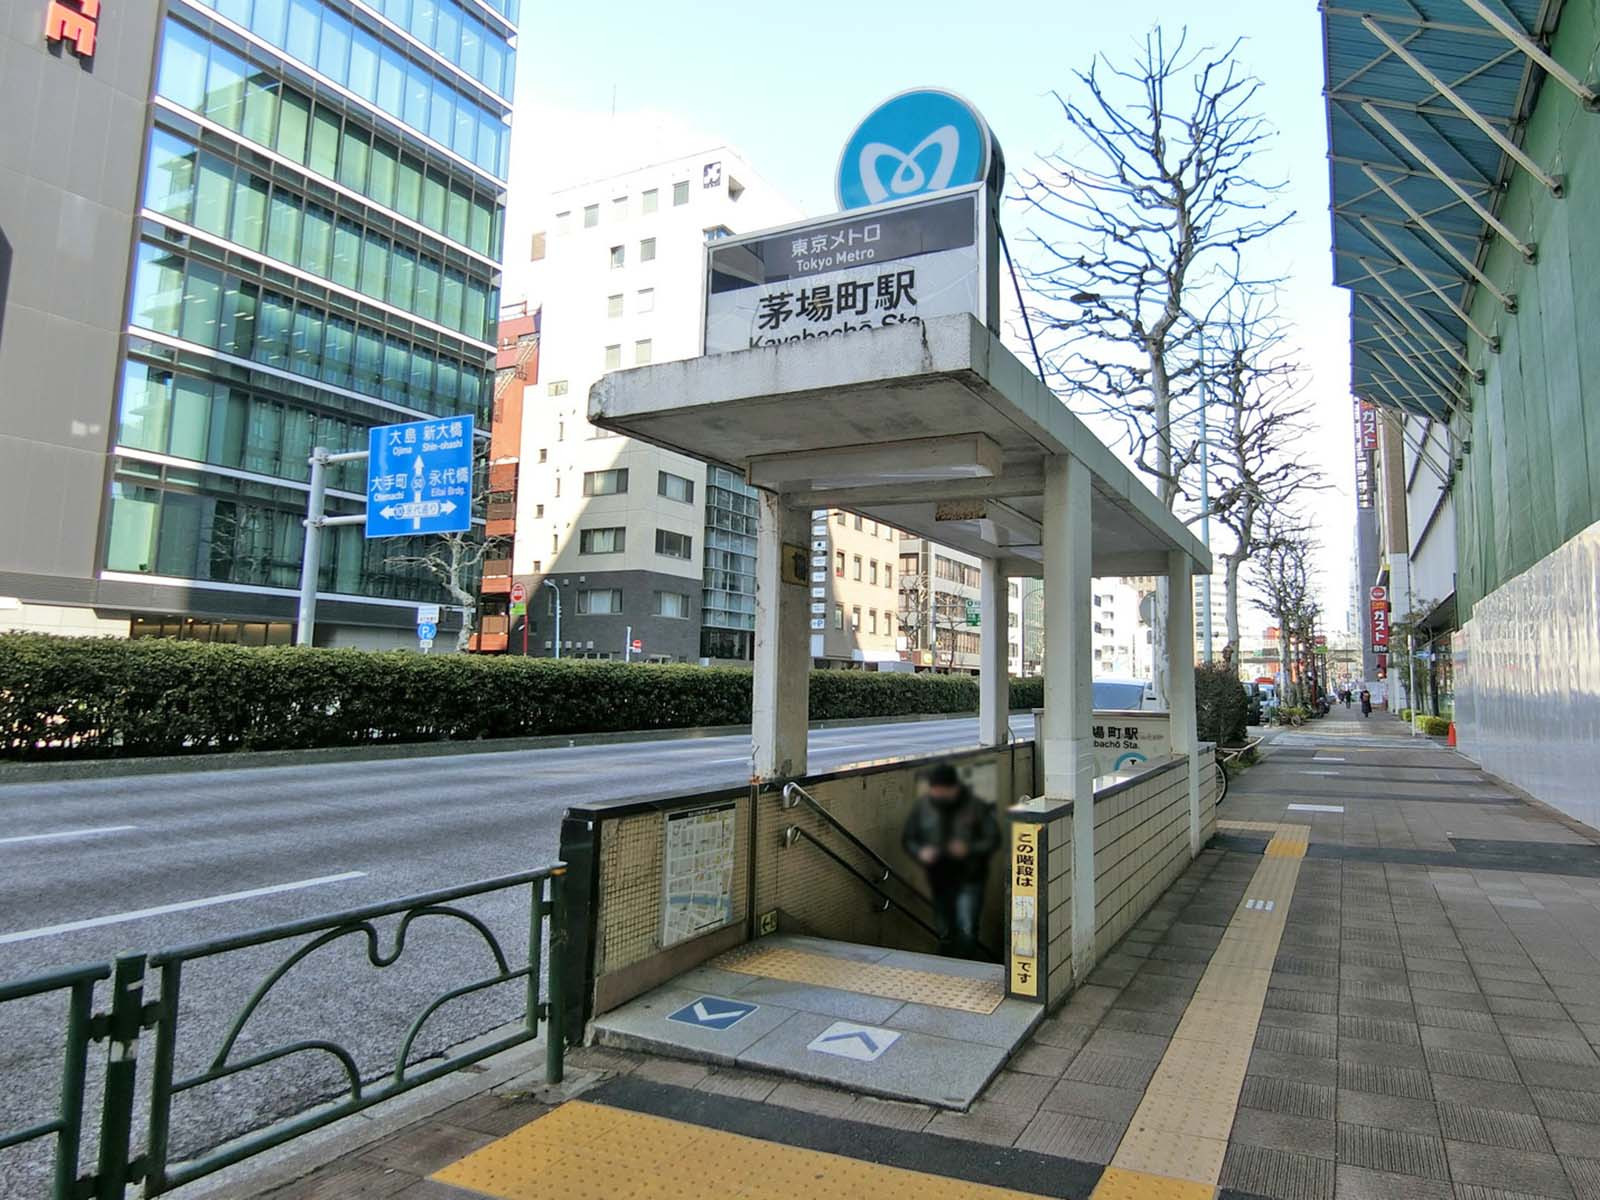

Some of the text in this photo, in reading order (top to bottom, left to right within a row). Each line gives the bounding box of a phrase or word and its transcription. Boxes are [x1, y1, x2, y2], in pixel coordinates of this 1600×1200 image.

[791, 223, 880, 258] 東京メトロ
[796, 248, 875, 273] Tokyo Metro
[758, 269, 917, 331] 茅場町駅
[389, 421, 463, 446] 大島 新大橋
[1362, 410, 1376, 448] ガスト
[370, 473, 409, 492] 大手町
[429, 467, 469, 487] 永代橋
[1374, 610, 1385, 642] ガスト
[1016, 833, 1035, 888] この階段は
[1017, 961, 1032, 984] です
